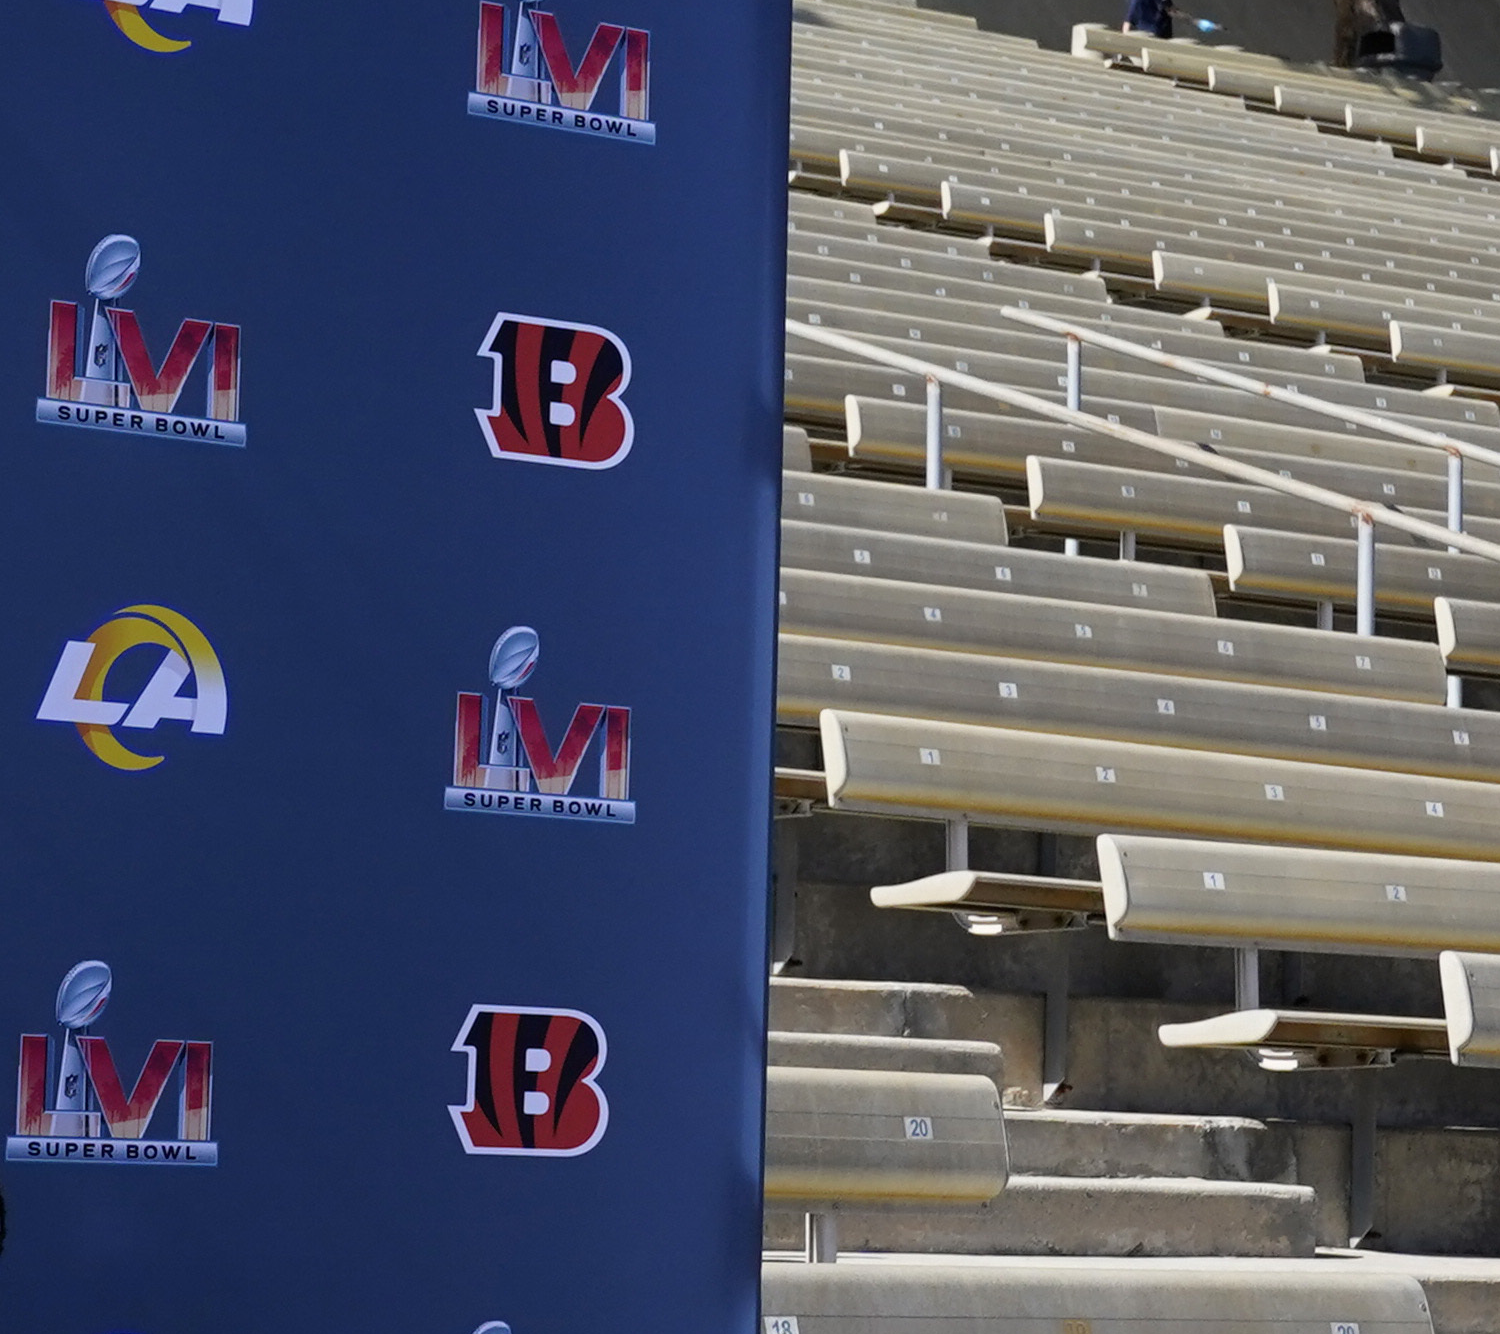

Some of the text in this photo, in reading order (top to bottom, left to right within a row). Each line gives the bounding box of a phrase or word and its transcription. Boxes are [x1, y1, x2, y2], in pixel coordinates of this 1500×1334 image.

[477, 1, 649, 120] LVI
[486, 99, 637, 136] SUPER BOWL
[46, 300, 239, 421] LVI
[474, 312, 633, 469] B
[57, 404, 226, 439] SUPER BOWL
[35, 605, 226, 735] LA
[454, 691, 629, 799] LVI
[463, 791, 617, 817] SUPER BOWL
[16, 1034, 211, 1139] LVI
[447, 1005, 609, 1155] B
[910, 1119, 928, 1137] 20
[27, 1140, 197, 1159] SUPER BOWL
